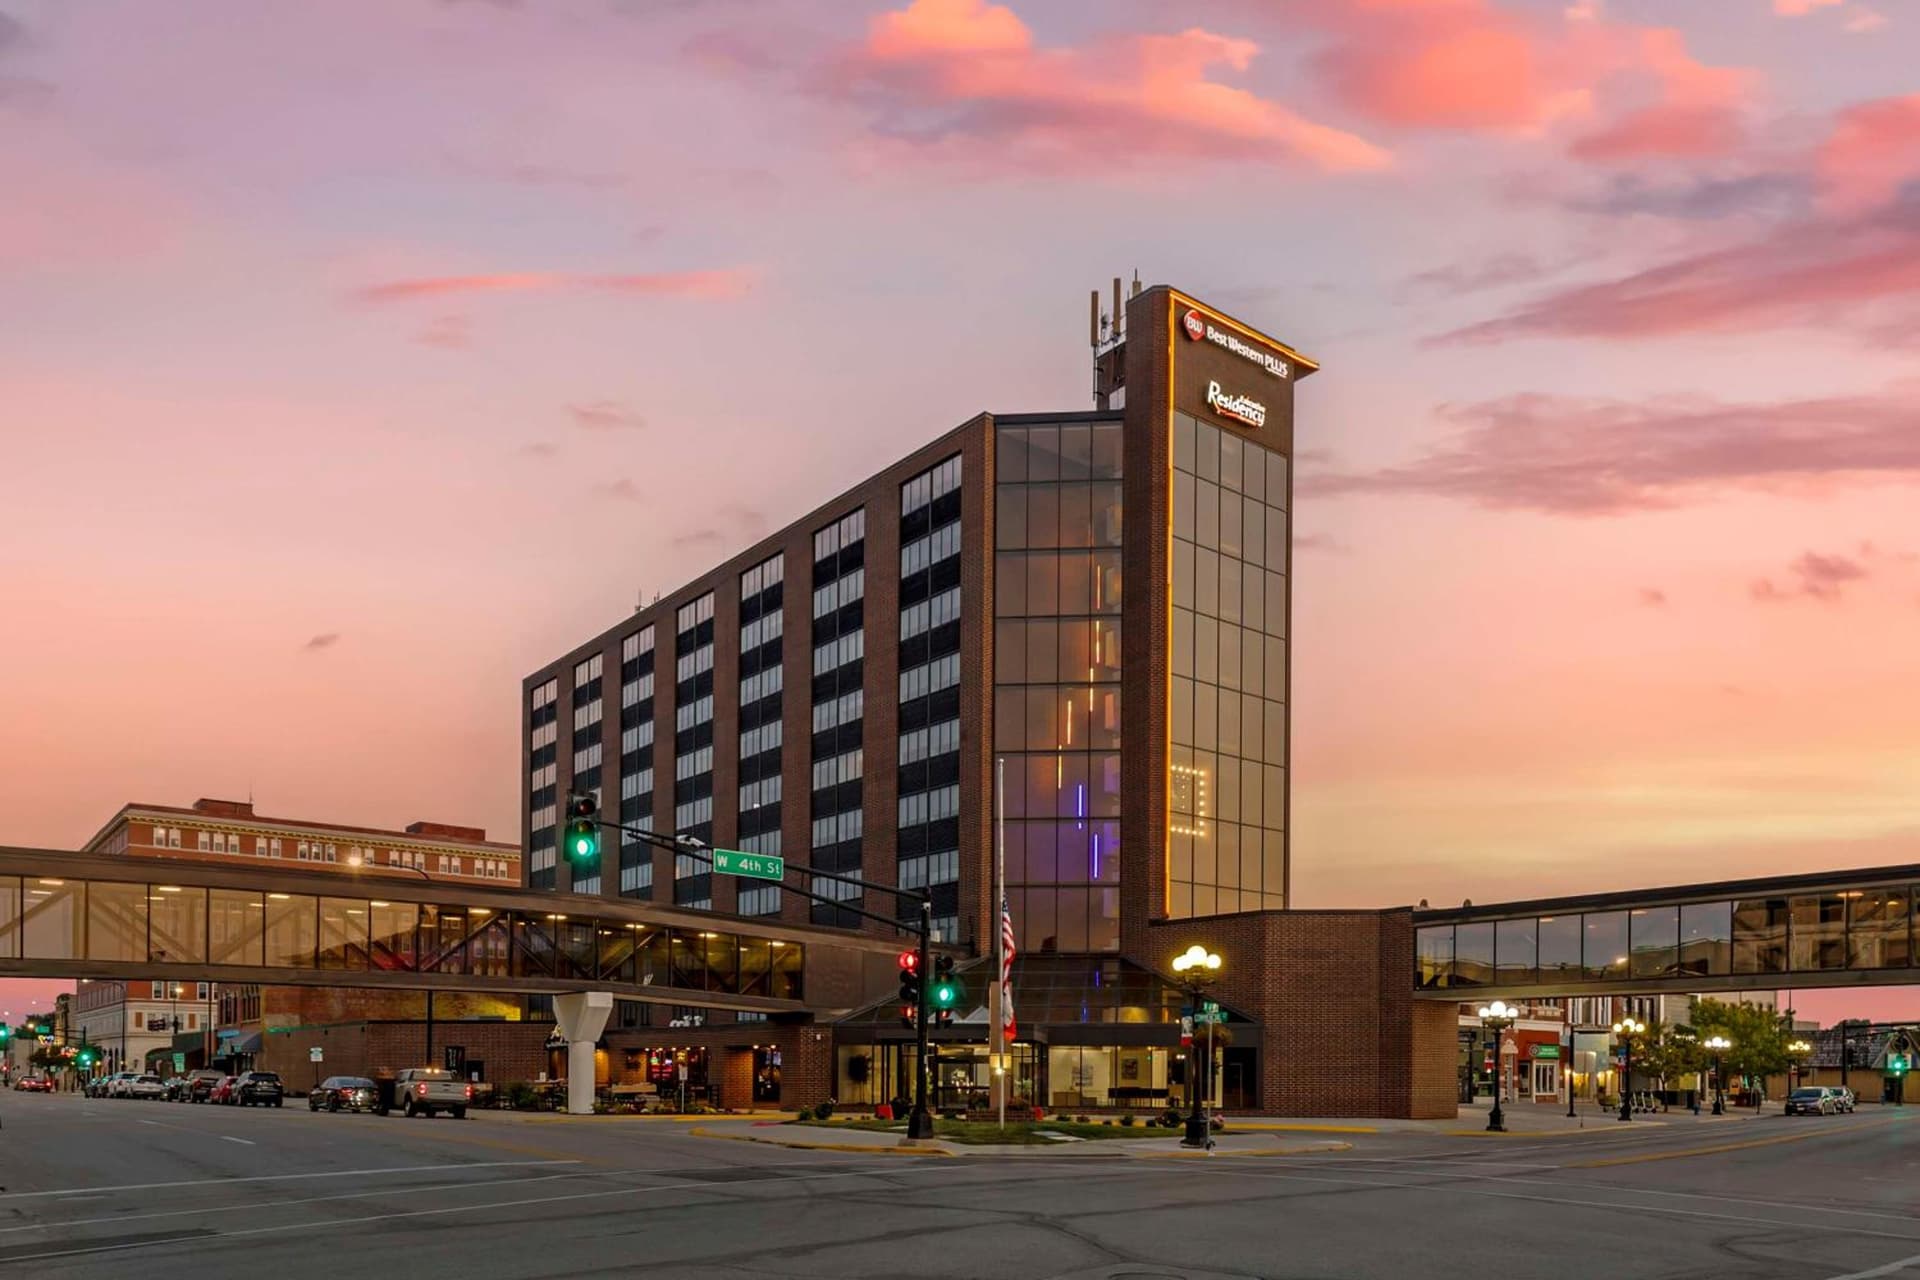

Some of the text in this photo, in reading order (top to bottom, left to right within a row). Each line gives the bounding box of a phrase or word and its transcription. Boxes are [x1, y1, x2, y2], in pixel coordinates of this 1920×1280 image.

[1206, 325, 1288, 377] Best Western PLUS
[1208, 380, 1265, 427] Residency
[717, 855, 780, 875] W 4th St
